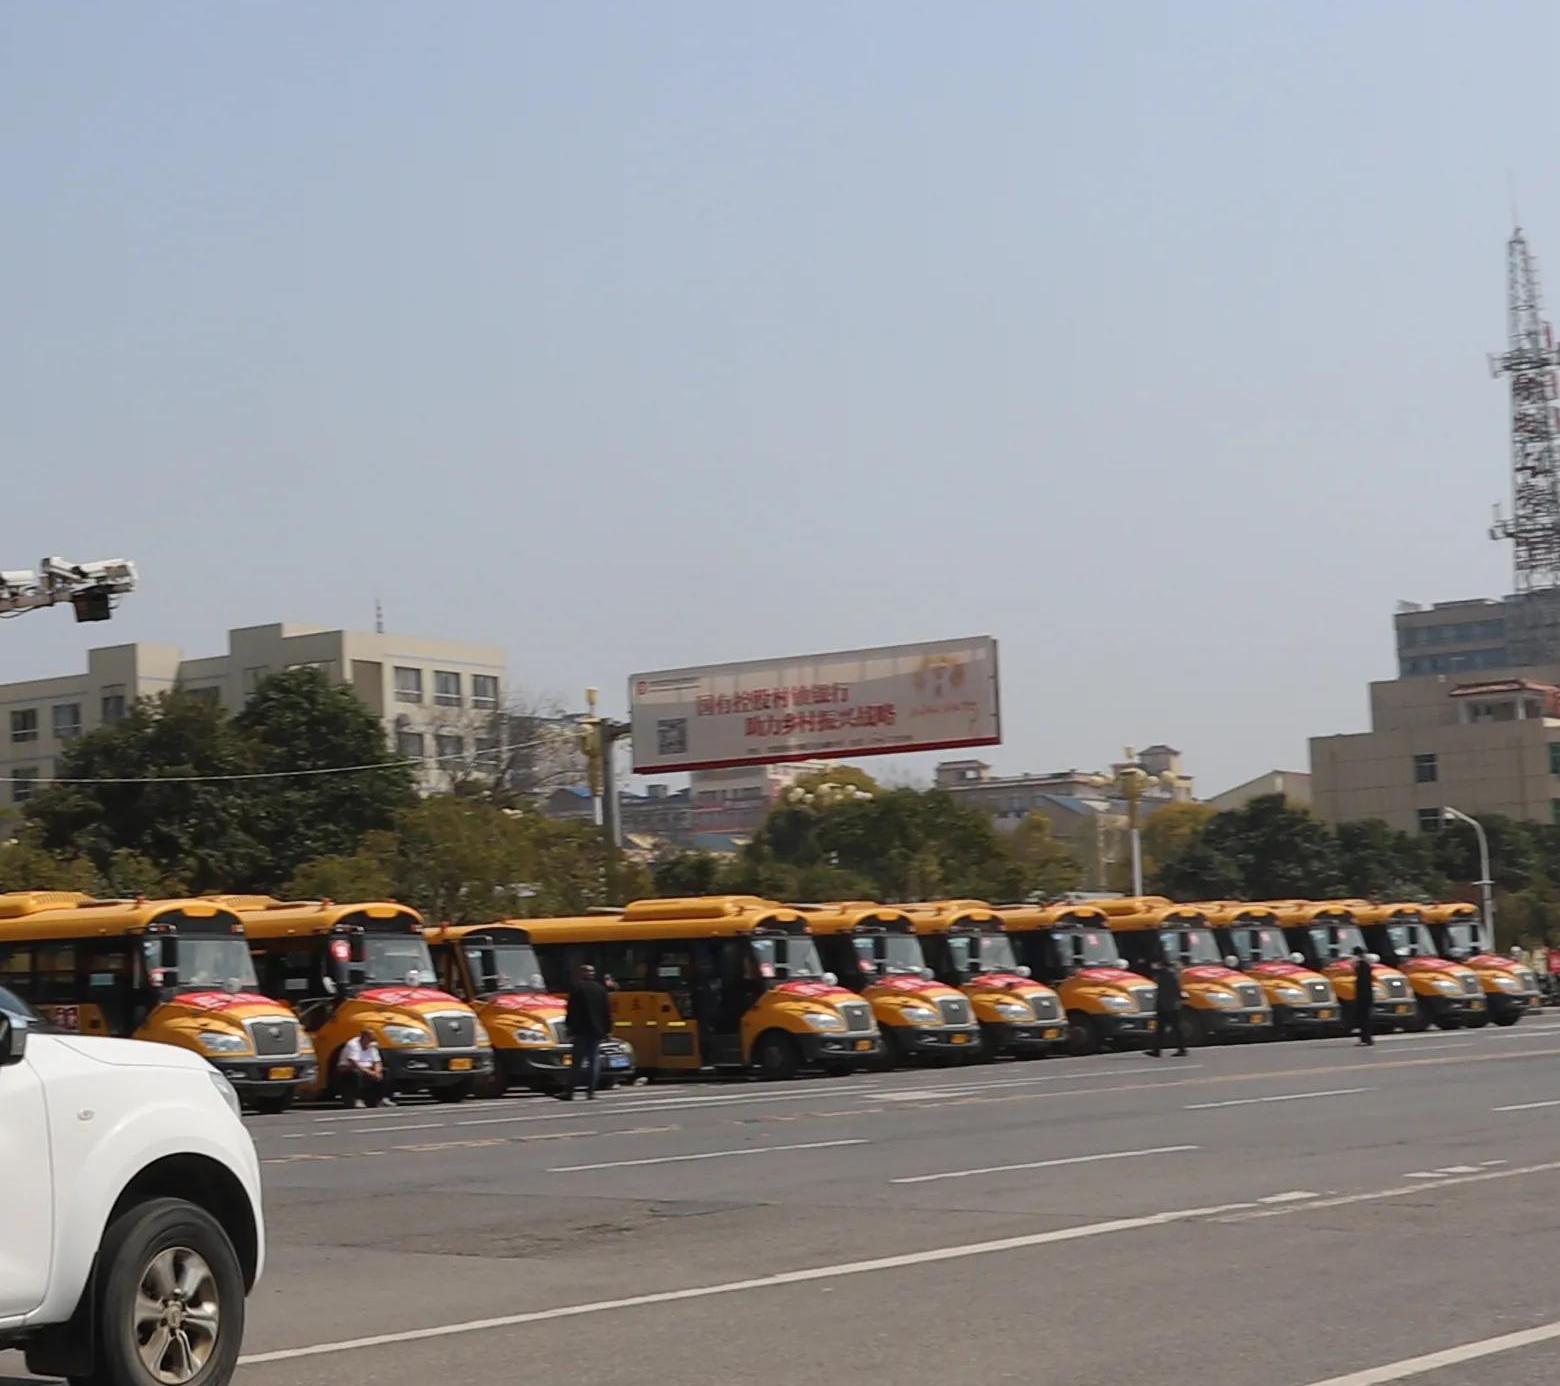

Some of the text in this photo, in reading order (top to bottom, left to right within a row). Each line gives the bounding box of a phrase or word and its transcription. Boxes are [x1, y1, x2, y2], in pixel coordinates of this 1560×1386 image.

[744, 703, 897, 736] 助力乡村振兴战略
